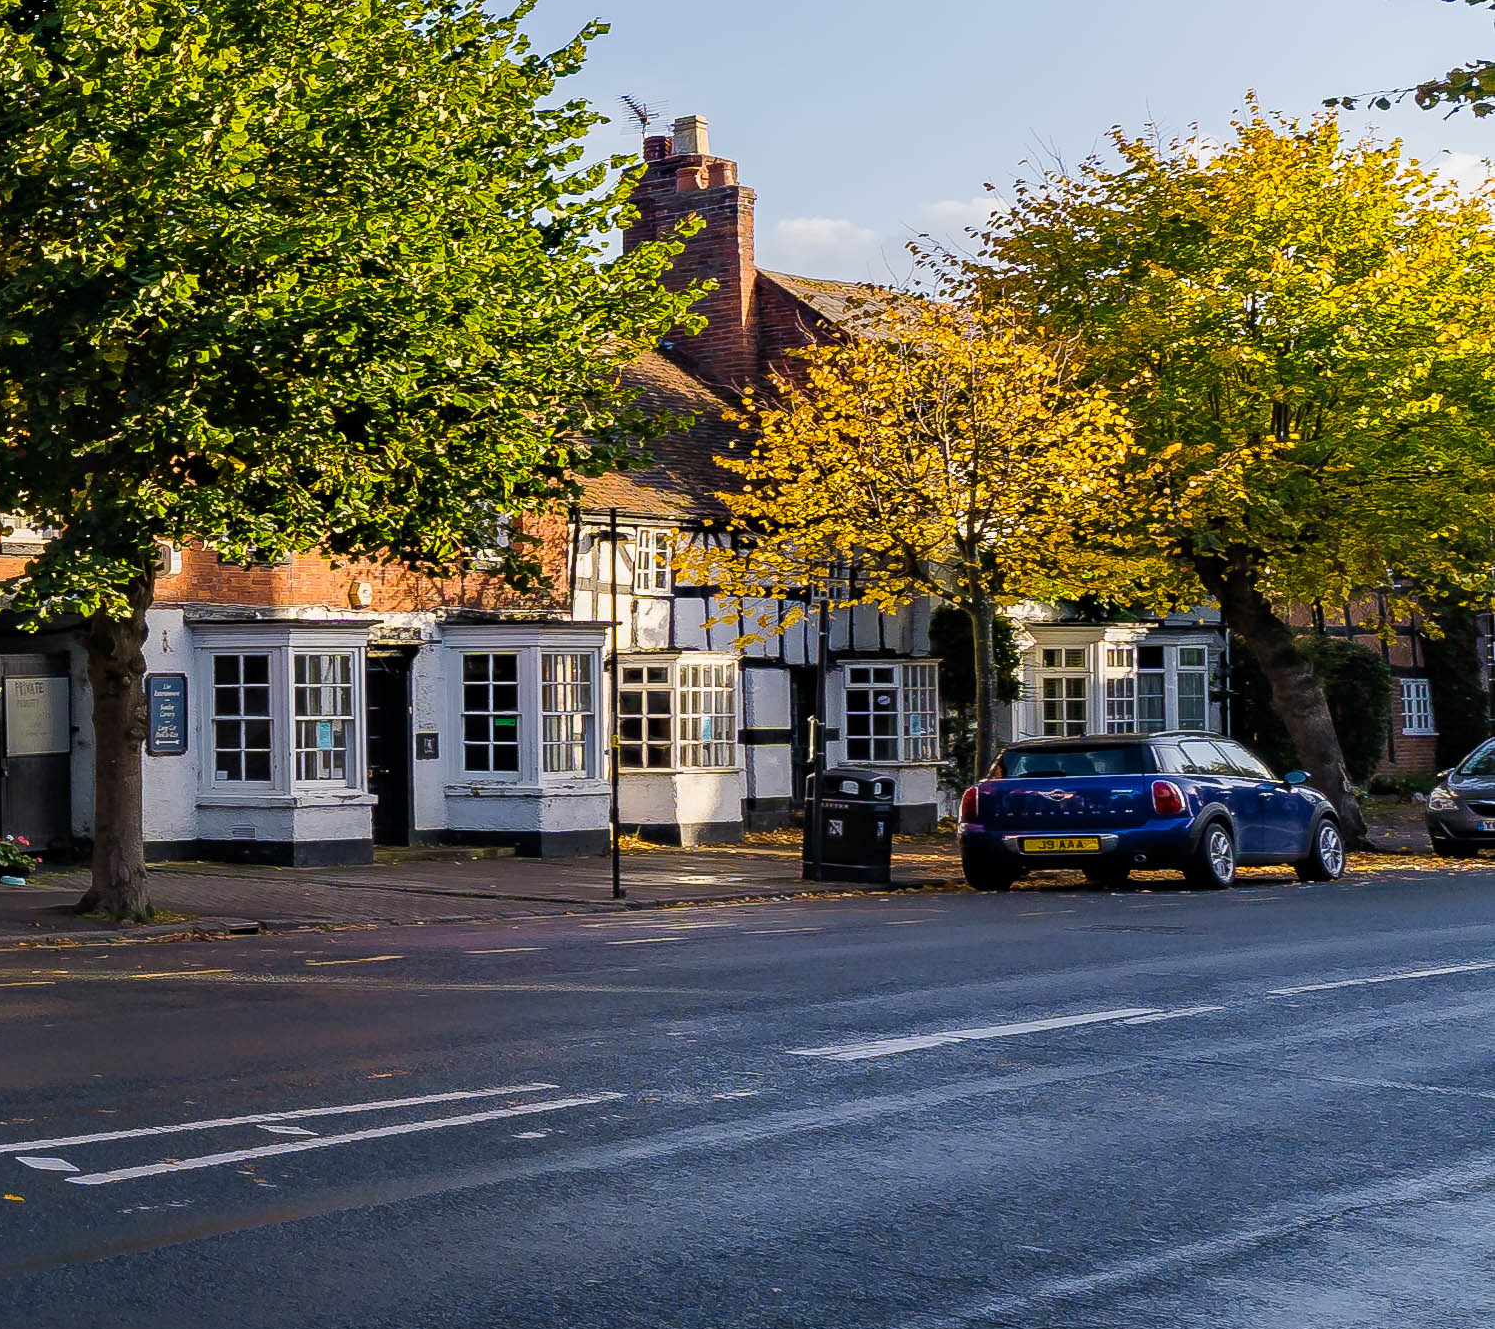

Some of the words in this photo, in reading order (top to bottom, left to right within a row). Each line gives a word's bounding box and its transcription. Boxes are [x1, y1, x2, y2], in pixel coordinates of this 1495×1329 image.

[15, 681, 45, 696] PRIVATE
[1038, 840, 1055, 849] J9
[1058, 839, 1084, 849] AAA
